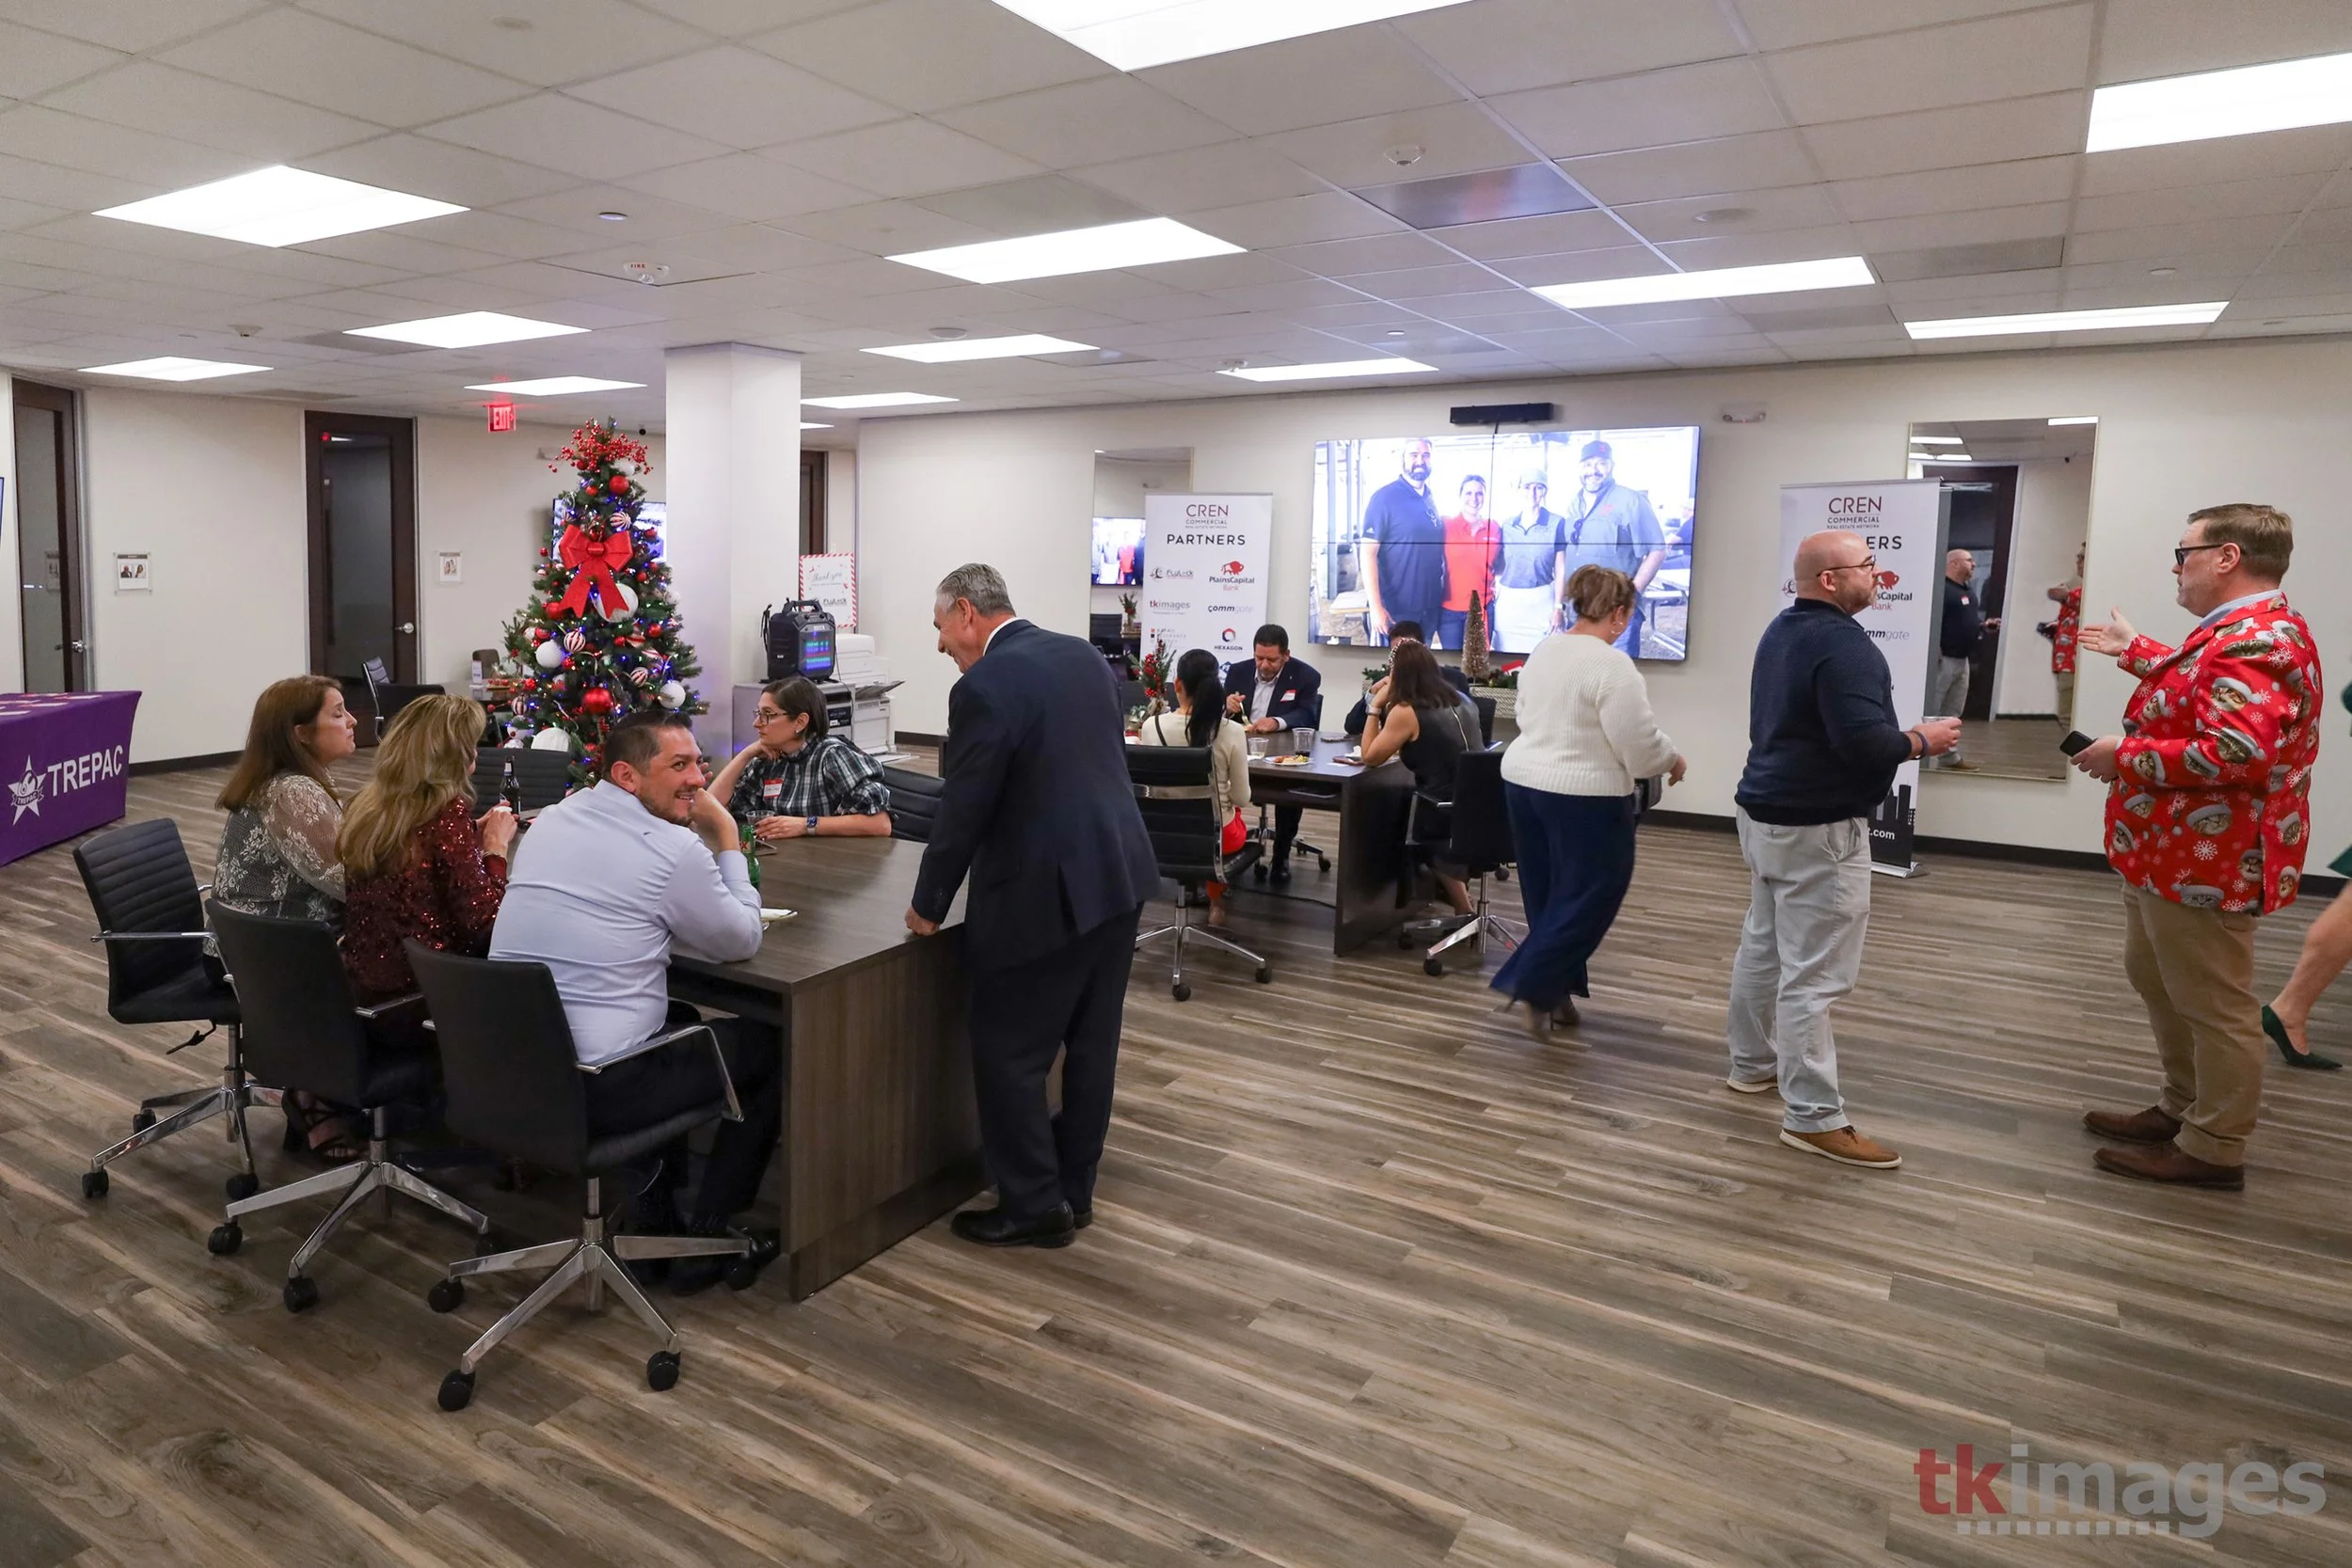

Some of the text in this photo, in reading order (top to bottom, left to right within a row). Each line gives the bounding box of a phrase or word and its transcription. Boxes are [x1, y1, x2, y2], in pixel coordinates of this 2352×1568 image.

[1185, 504, 1229, 517] CREN
[1828, 496, 1883, 515] CREN
[1827, 515, 1880, 524] COMMERCIAL
[1167, 534, 1246, 546] PARTNERS
[1209, 576, 1255, 585] PlainsCapital
[1877, 592, 1913, 602] sCapital
[1150, 600, 1190, 610] tkimages
[1871, 602, 1892, 610] Bank
[1866, 630, 1910, 641] mmgate
[47, 744, 123, 797] TREPAC
